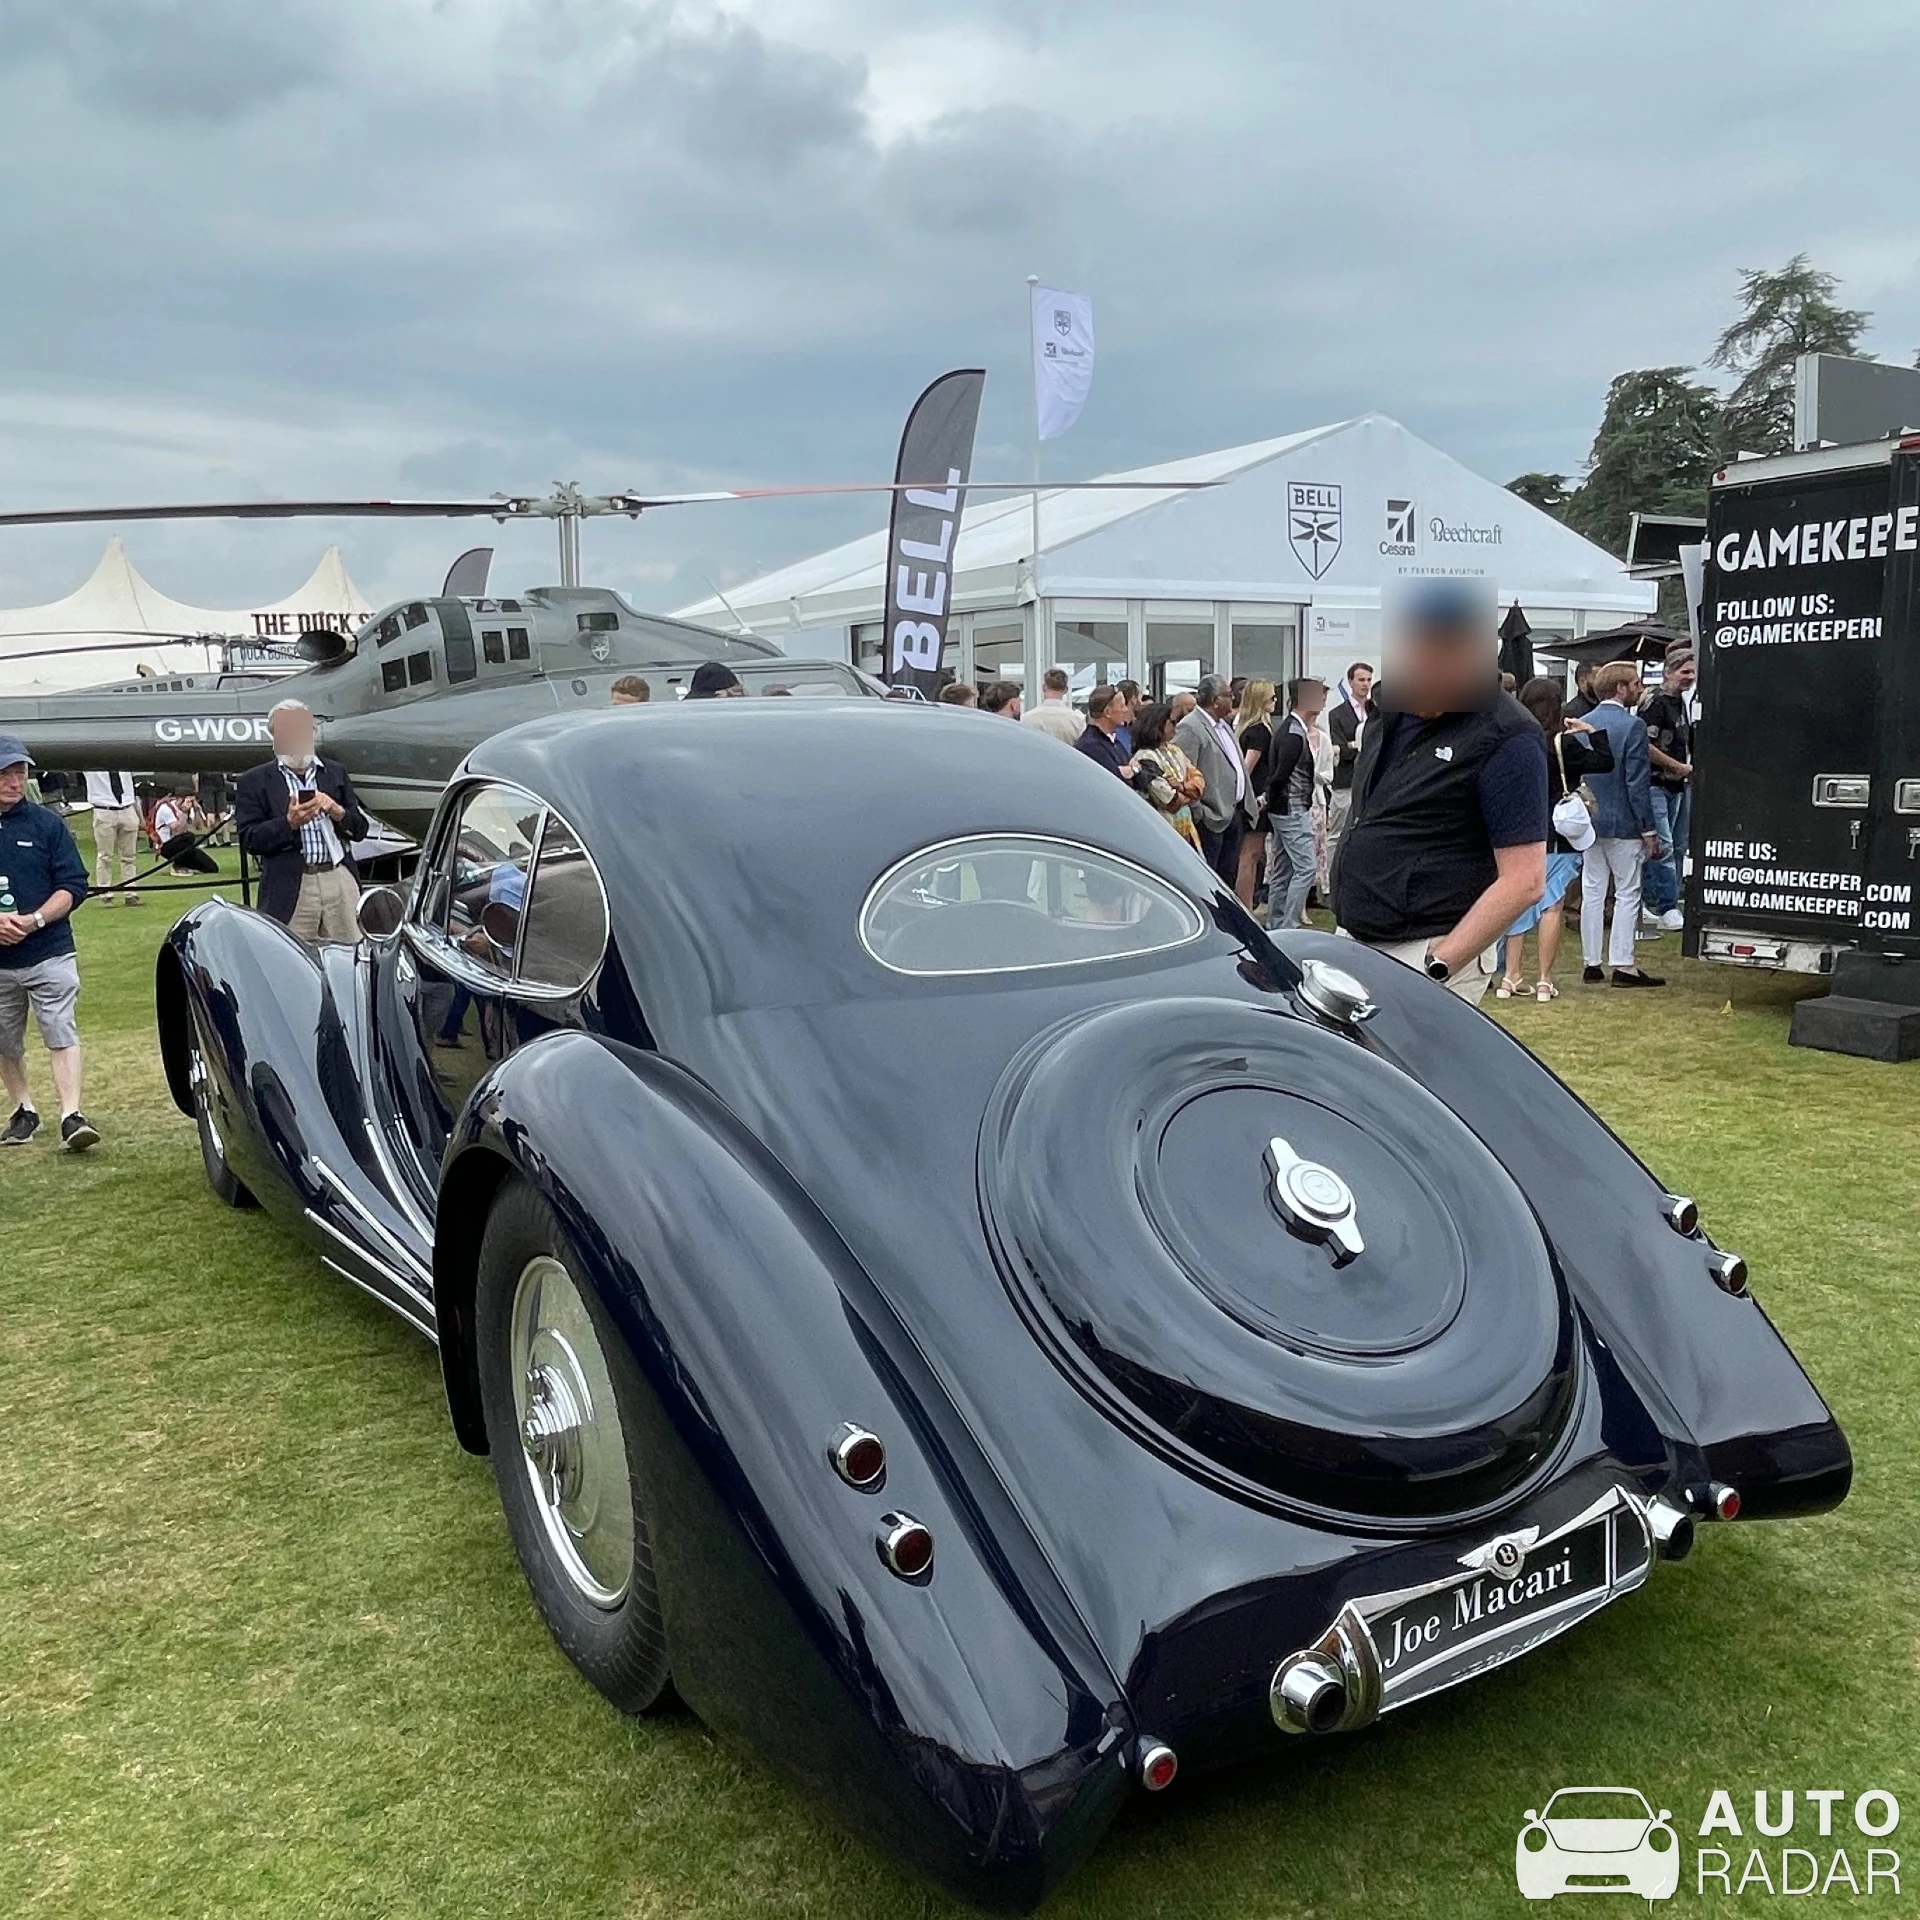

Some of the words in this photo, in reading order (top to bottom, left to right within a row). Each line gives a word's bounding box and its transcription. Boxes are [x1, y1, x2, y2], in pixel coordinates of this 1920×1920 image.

[1293, 488, 1336, 508] BELL
[1429, 517, 1502, 544] Beechcraft
[1379, 541, 1415, 556] Cessna
[893, 467, 961, 674] BELL
[1716, 597, 1795, 621] FOLLOW
[1801, 593, 1835, 615] US:
[251, 613, 294, 635] THE
[298, 612, 353, 635] DUCK
[358, 612, 376, 625] S
[1705, 840, 1744, 859] HIRE
[1748, 843, 1777, 861] US:
[1384, 1616, 1442, 1668] Joe
[1451, 1546, 1573, 1631] Macari
